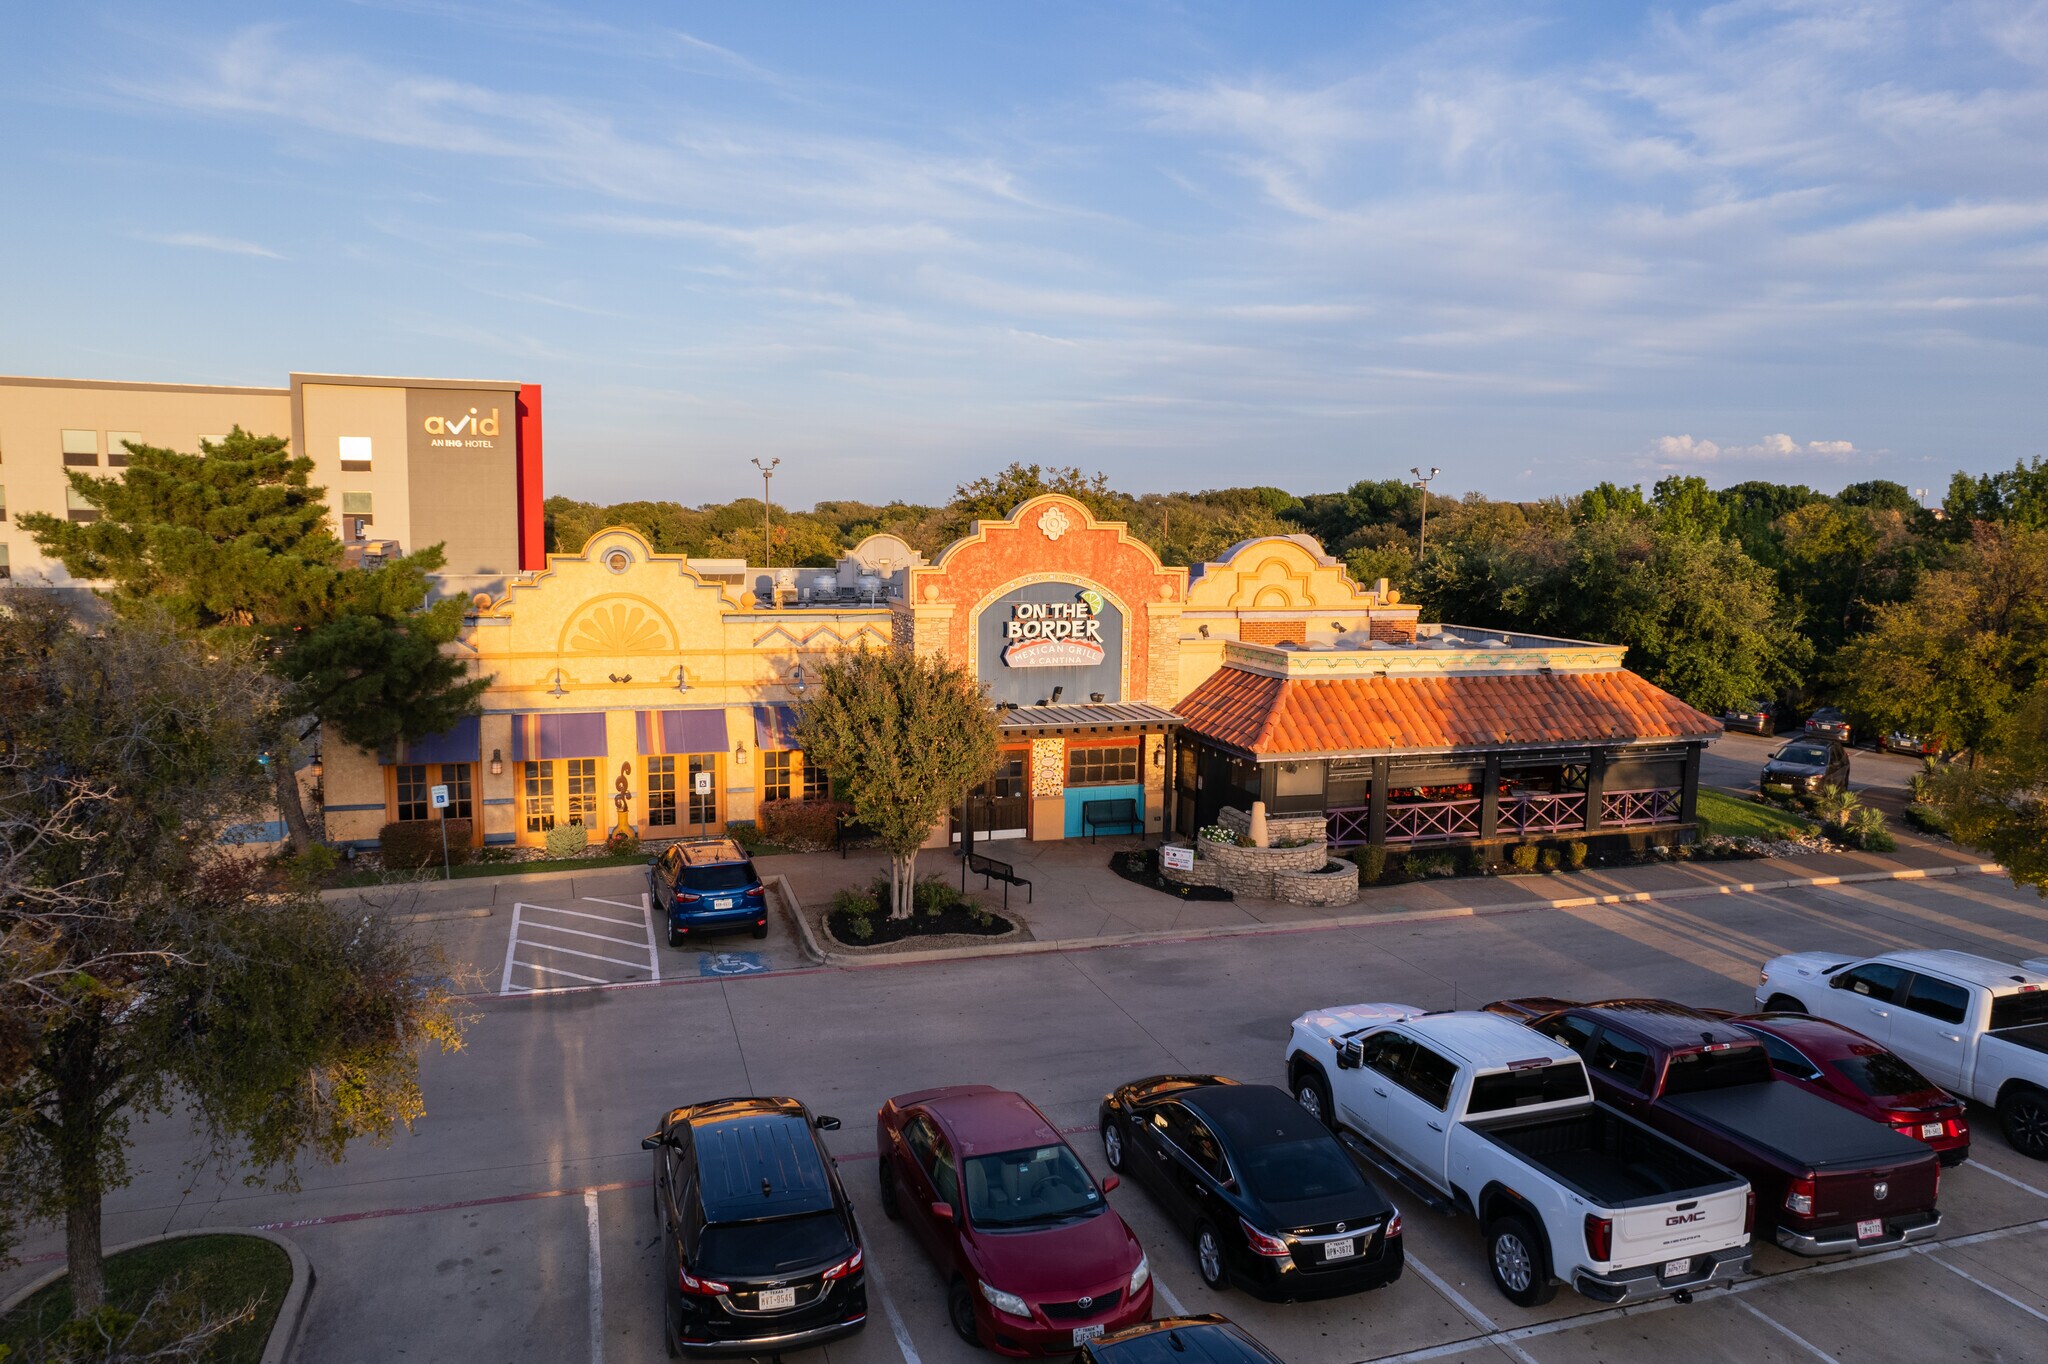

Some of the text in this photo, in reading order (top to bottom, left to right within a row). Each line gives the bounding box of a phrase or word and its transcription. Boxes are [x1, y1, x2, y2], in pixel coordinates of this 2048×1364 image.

[424, 407, 499, 436] avid
[431, 439, 444, 447] AN
[445, 440, 462, 448] IHG
[1017, 602, 1088, 619] ON THE
[1008, 620, 1104, 644] BORDER
[1014, 644, 1098, 663] MEXICAN GRILL
[1029, 656, 1082, 665] & CANTINA
[1665, 1210, 1706, 1227] GMC
[760, 1293, 793, 1307] MVT-9545
